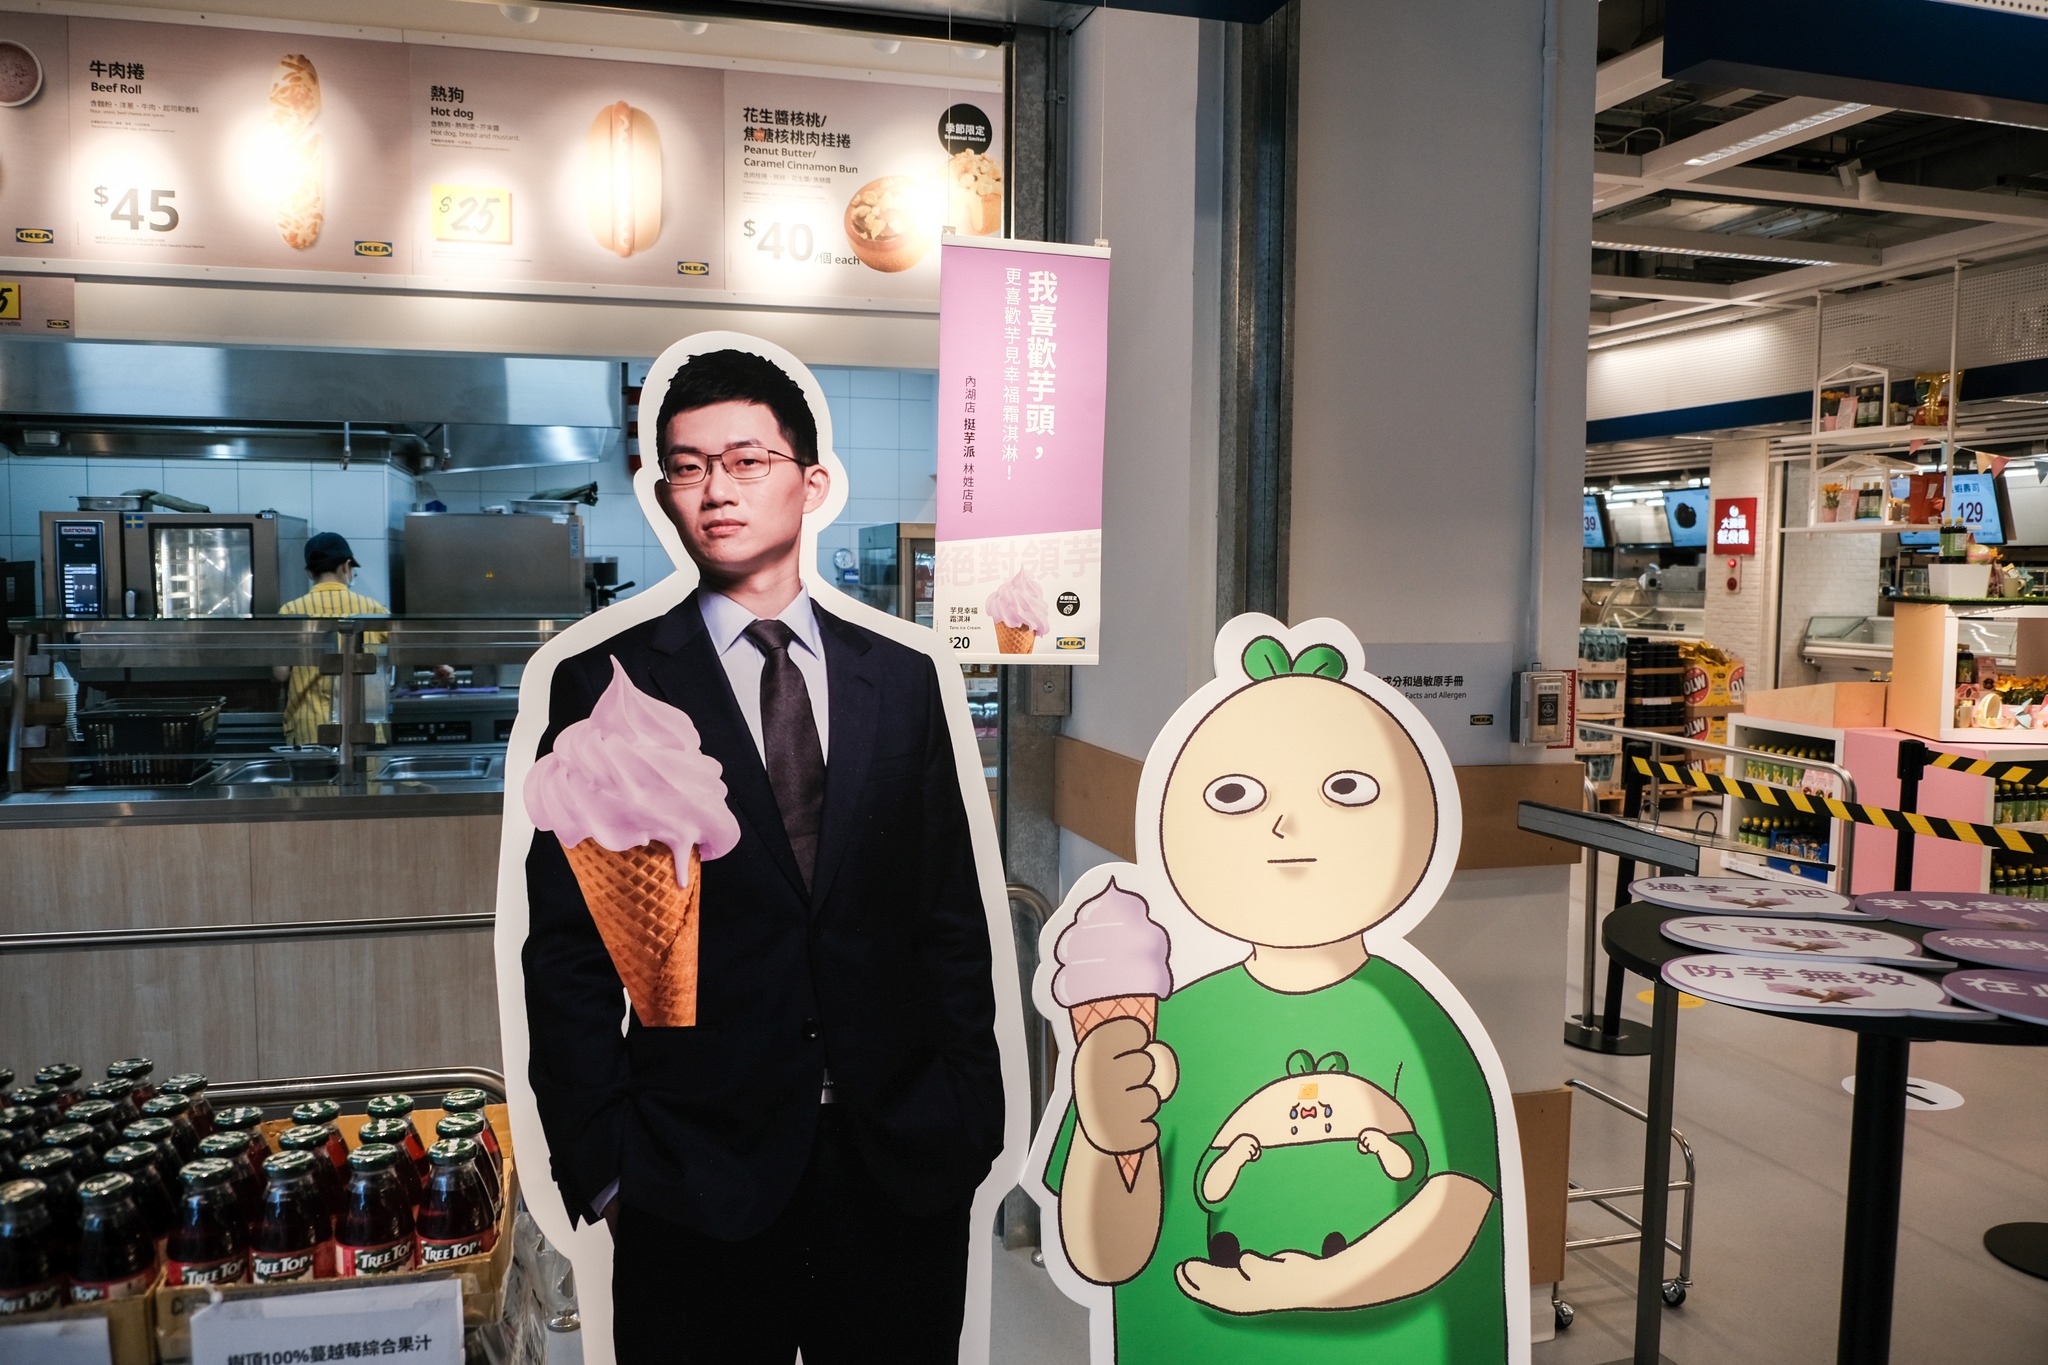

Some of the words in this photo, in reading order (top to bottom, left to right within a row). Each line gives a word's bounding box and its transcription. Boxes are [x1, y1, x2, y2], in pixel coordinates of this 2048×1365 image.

[89, 60, 145, 80] 牛肉捲
[91, 82, 118, 93] Beef
[120, 84, 142, 94] Roll
[430, 85, 464, 103] 熱狗
[430, 107, 450, 117] Hot
[453, 108, 474, 120] dog
[744, 145, 779, 156] Peanut
[781, 147, 816, 158] Butter/
[744, 158, 785, 168] Caramel
[787, 161, 837, 172] Cinnamon
[839, 164, 858, 173] Bun
[94, 184, 179, 232] $45
[439, 194, 501, 235] $25
[19, 230, 51, 240] IKEA
[357, 243, 391, 254] IKEA
[679, 264, 707, 273] IKEA
[835, 256, 860, 265] each
[48, 320, 68, 328] IKEA
[963, 418, 976, 458] 挺芋派
[962, 463, 975, 513] 林姓店員
[1958, 502, 1983, 523] 129
[949, 636, 970, 649] $20
[1058, 639, 1083, 647] IKEA
[1379, 675, 1464, 688] 成分和過敏原手冊
[1684, 674, 1706, 696] OLW
[1405, 691, 1423, 699] Facts
[1424, 691, 1437, 699] and
[1438, 691, 1467, 700] Allergen
[1644, 882, 1829, 899] 過芋了吧
[1680, 921, 1888, 941] 不可理芋
[1681, 964, 1916, 987] 防芋無效
[359, 1248, 391, 1269] TREE
[424, 1246, 449, 1261] TREE
[450, 1242, 477, 1257] TOP
[254, 1259, 279, 1274] TREE
[281, 1255, 308, 1270] TOP
[187, 1267, 218, 1285] TREE
